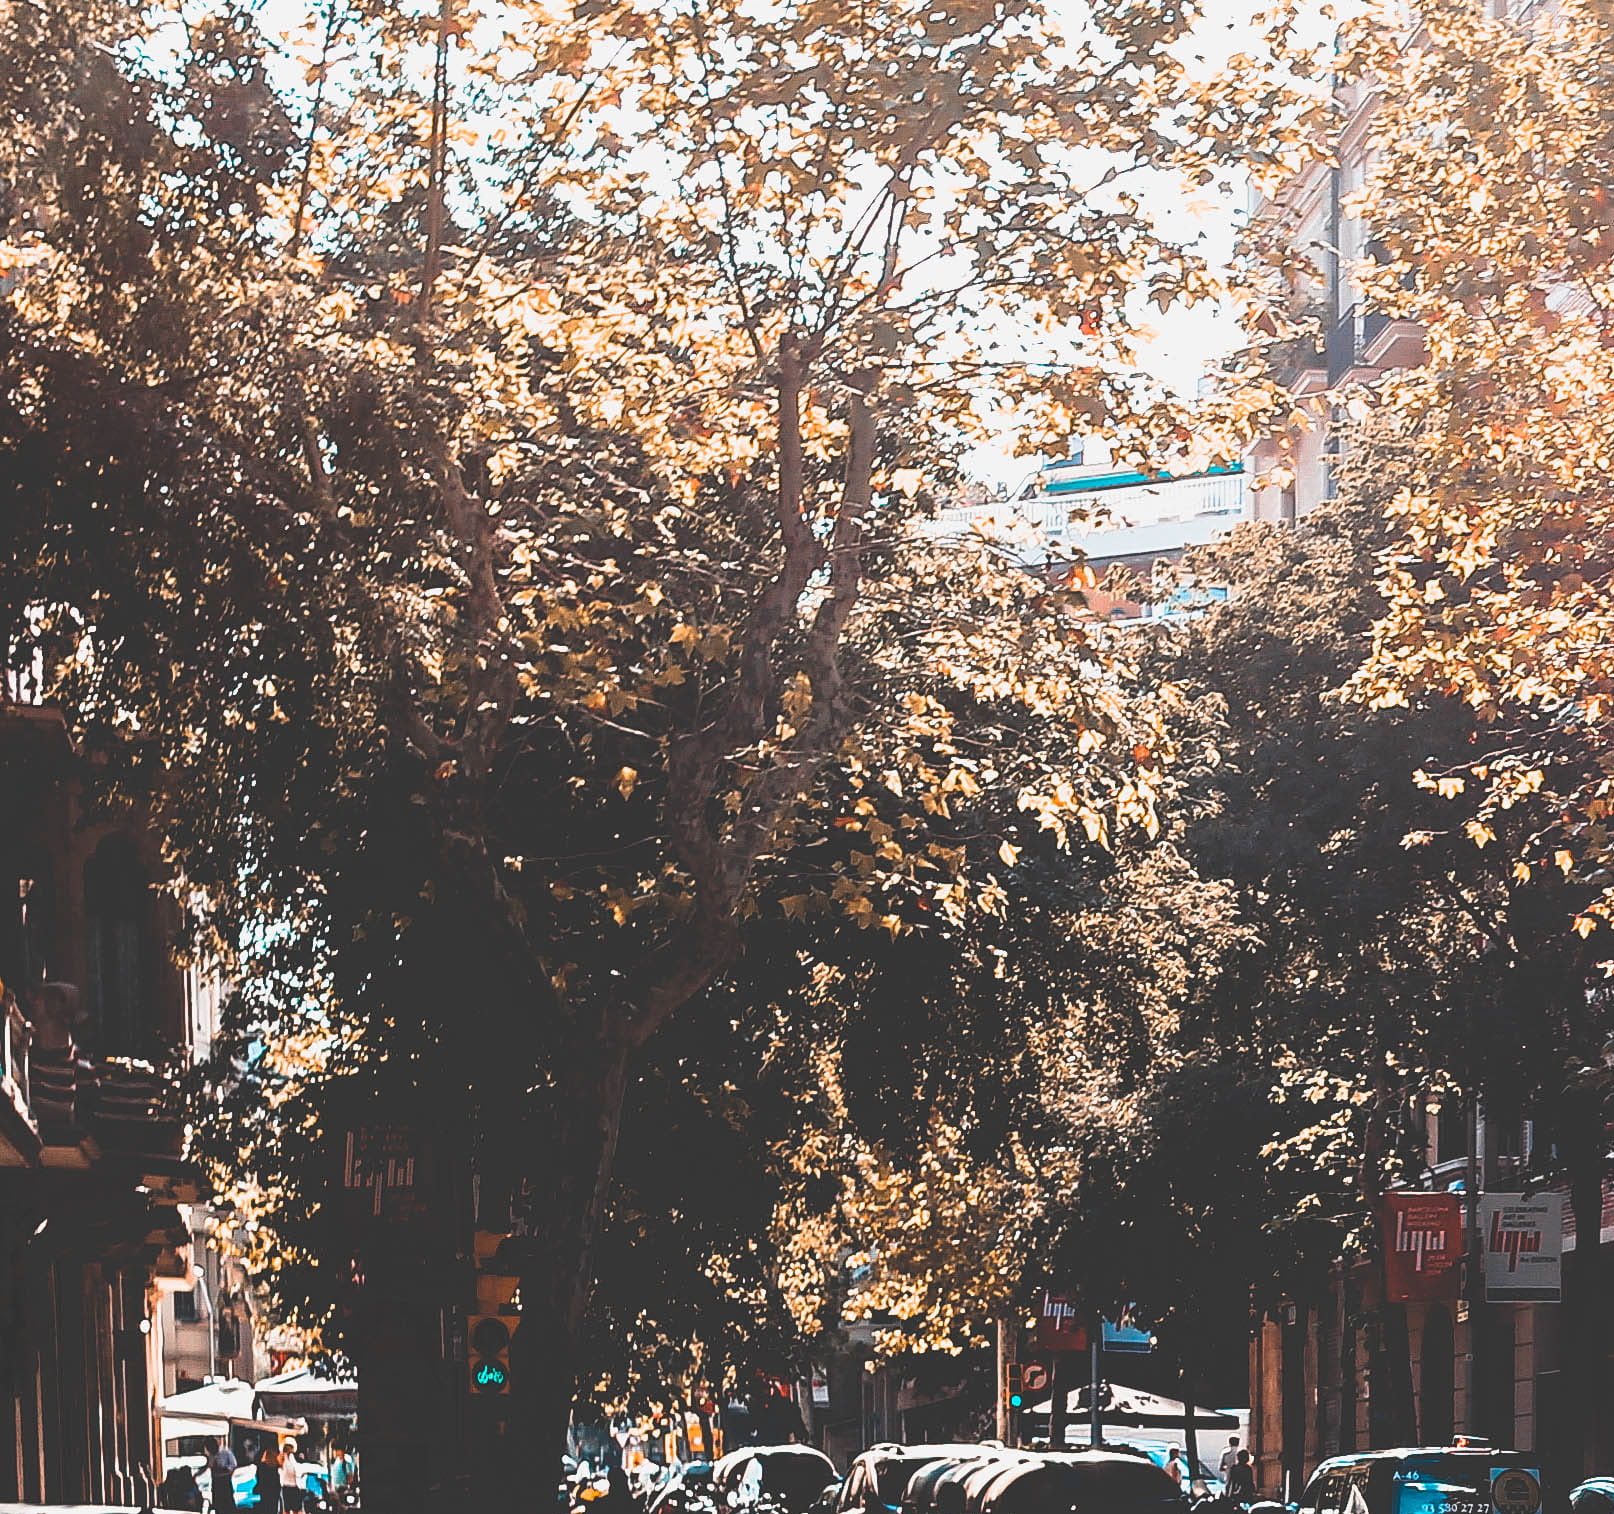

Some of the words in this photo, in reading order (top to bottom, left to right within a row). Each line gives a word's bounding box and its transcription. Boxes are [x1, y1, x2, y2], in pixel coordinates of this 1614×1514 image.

[1392, 1470, 1420, 1481] A-46
[1438, 1501, 1458, 1514] 580
[1460, 1503, 1474, 1514] 27
[1476, 1503, 1490, 1514] 27
